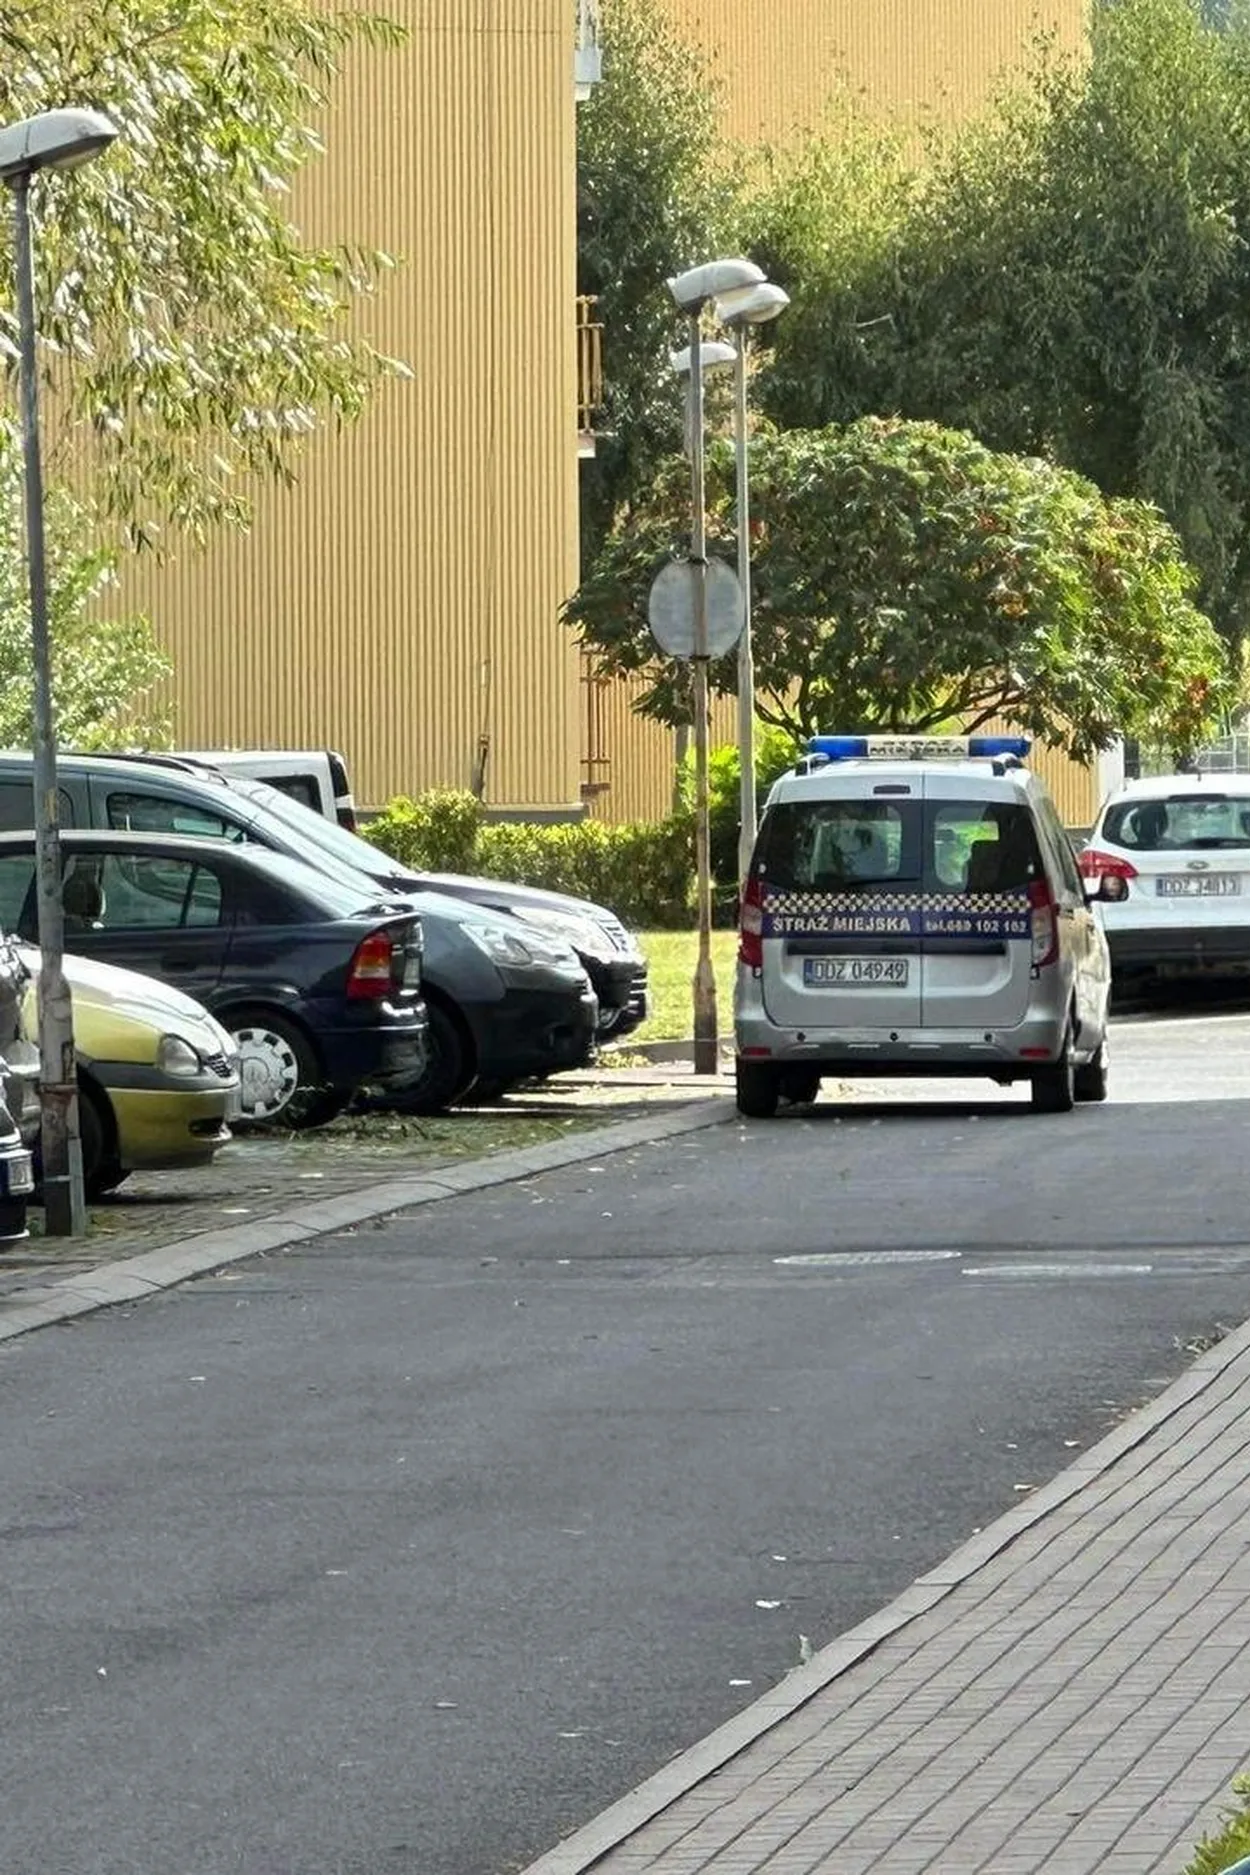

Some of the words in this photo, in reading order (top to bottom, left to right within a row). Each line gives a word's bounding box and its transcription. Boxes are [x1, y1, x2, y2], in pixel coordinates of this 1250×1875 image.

[773, 914, 829, 931] STRAŻ
[832, 917, 911, 931] MIEJSKA
[814, 962, 846, 980] DDZ
[851, 962, 904, 980] 04949
